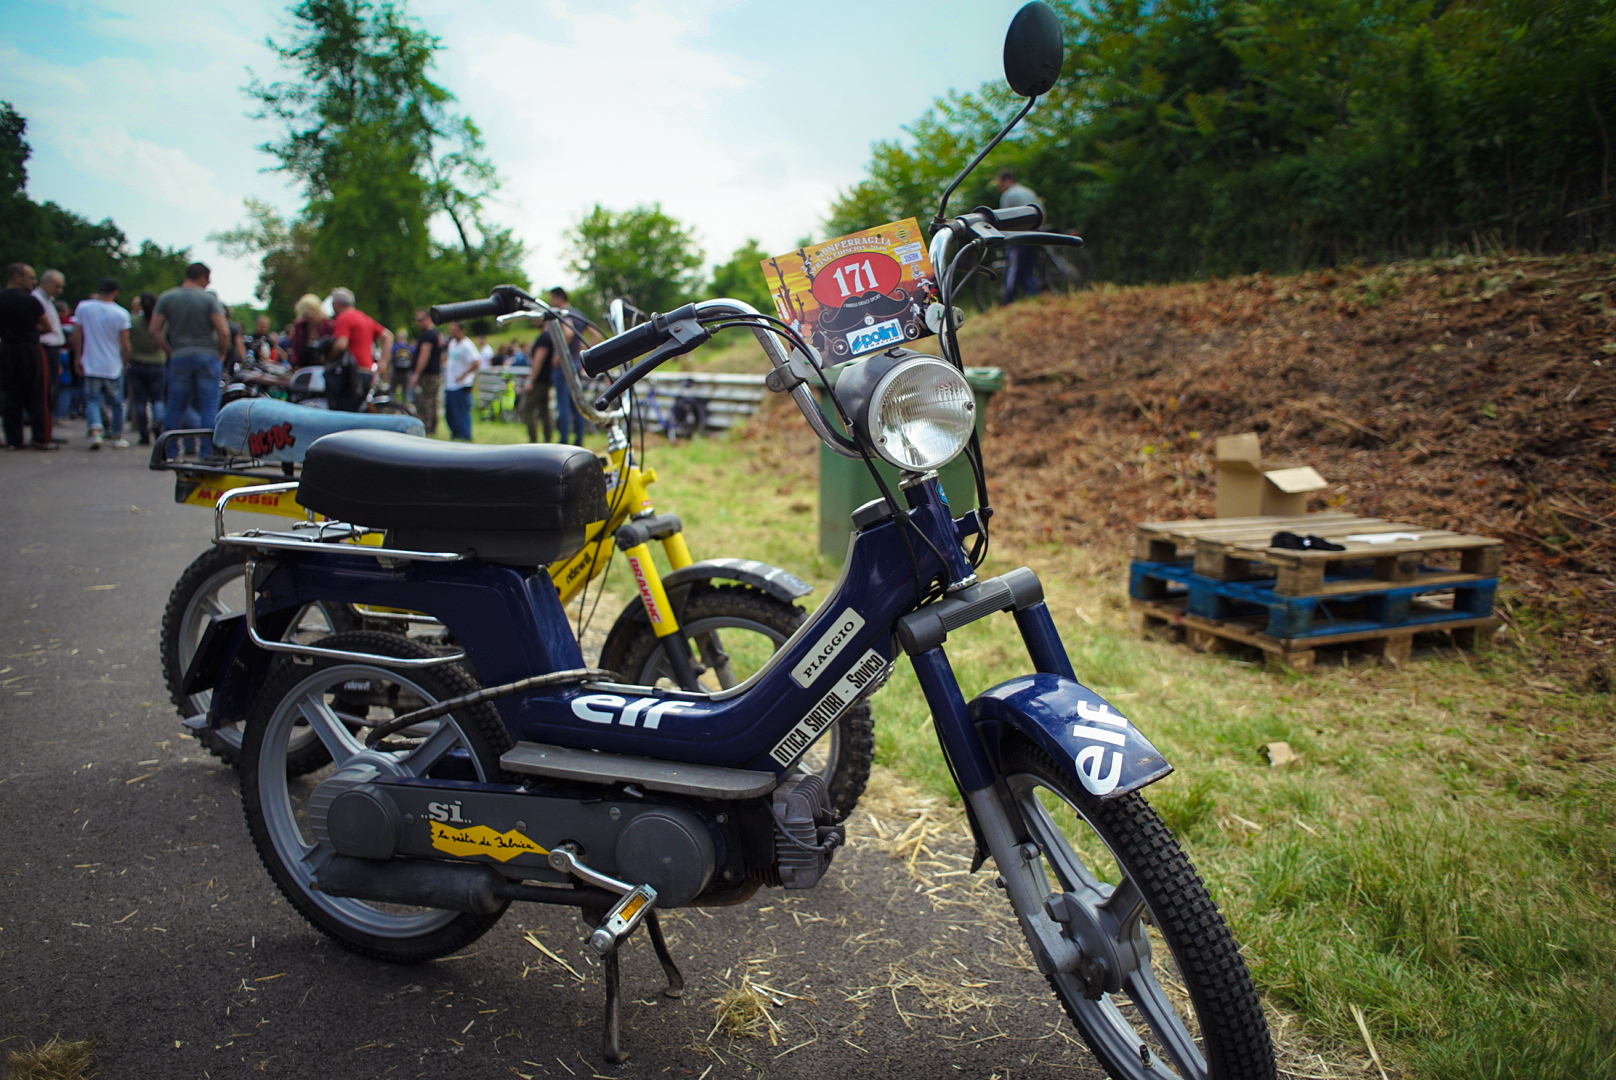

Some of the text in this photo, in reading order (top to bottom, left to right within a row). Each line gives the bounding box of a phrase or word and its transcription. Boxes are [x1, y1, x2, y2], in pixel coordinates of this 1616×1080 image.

[833, 259, 879, 297] 171
[861, 322, 899, 348] polini
[197, 487, 280, 507] MAOSSI
[629, 557, 662, 623] BRAKING
[803, 621, 854, 678] PIAGGIO
[571, 694, 696, 730] elf
[773, 727, 811, 764] OTTICA
[803, 691, 846, 732] SIRTORI
[1073, 700, 1128, 795] elf
